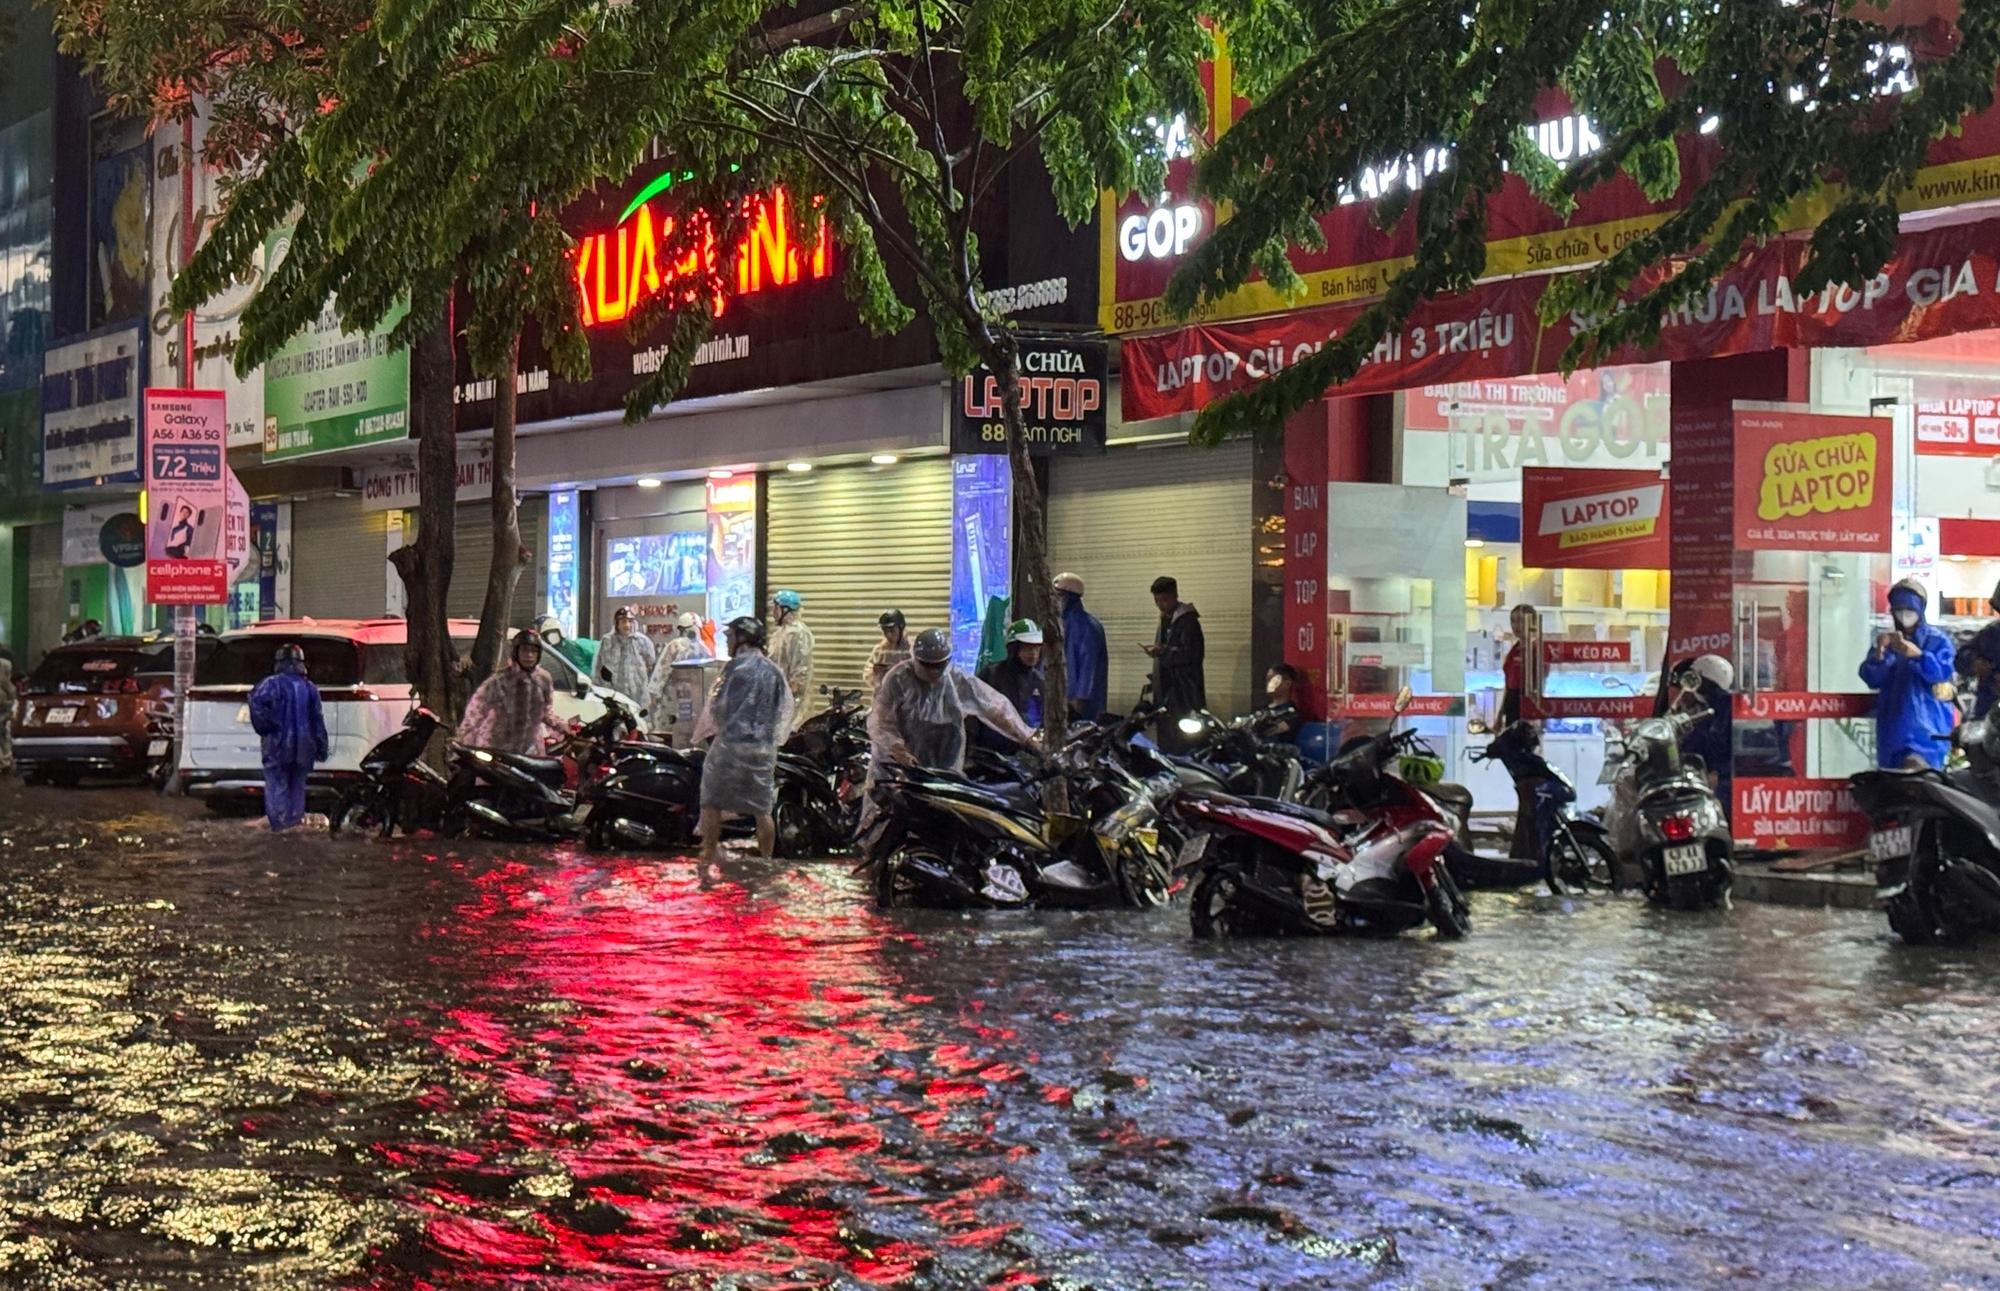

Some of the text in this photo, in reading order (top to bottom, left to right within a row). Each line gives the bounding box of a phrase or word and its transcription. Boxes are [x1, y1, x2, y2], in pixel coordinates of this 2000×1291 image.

[1120, 192, 1197, 261] GÓP
[1527, 239, 1589, 264] Sửa chữa
[1322, 276, 1376, 297] Bán hàng
[1026, 349, 1085, 373] CHỮA
[1157, 352, 1240, 392] LAPTOP
[1246, 340, 1284, 378] CŨ
[1410, 327, 1426, 359] 3
[1434, 308, 1514, 359] TRIỆU
[965, 375, 1100, 421] LAPTOP
[1485, 383, 1507, 404] THỊ
[1510, 382, 1566, 404] TRƯỜNG
[151, 403, 192, 411] SAMSUNG
[1948, 399, 1995, 416] LAPTOP
[164, 413, 208, 428] Galaxy
[153, 429, 220, 440] A56 A36 5G
[982, 422, 1081, 443] 88 ÀM NGHI
[157, 455, 216, 477] 7.2 Triệu
[1774, 441, 1868, 475] SỬA CHỮA
[366, 472, 392, 499] CÔNG
[395, 474, 407, 496] TY
[1776, 469, 1869, 509] LAPTOP
[1294, 484, 1318, 510] BÁN
[1561, 497, 1639, 526] LAPTOP
[1569, 531, 1588, 543] BẢO
[1590, 529, 1615, 542] HÀNH
[1626, 522, 1647, 534] NĂM
[1746, 529, 1762, 539] GIÁ
[1777, 529, 1795, 540] XEM
[1295, 533, 1317, 557] LAP
[1295, 580, 1317, 604] TOP
[1298, 623, 1314, 651] CŨ
[1672, 632, 1731, 654] LAPTOP
[1573, 645, 1621, 660] KÉO RA
[1563, 701, 1633, 713] KIM ANH
[1774, 698, 1846, 713] KIM ANH
[1742, 784, 1773, 814] LẤY
[1775, 789, 1834, 814] LAPTOP
[1754, 816, 1773, 835] SỬA
[1774, 816, 1801, 835] CHỮA
[1803, 815, 1823, 834] LẤY
